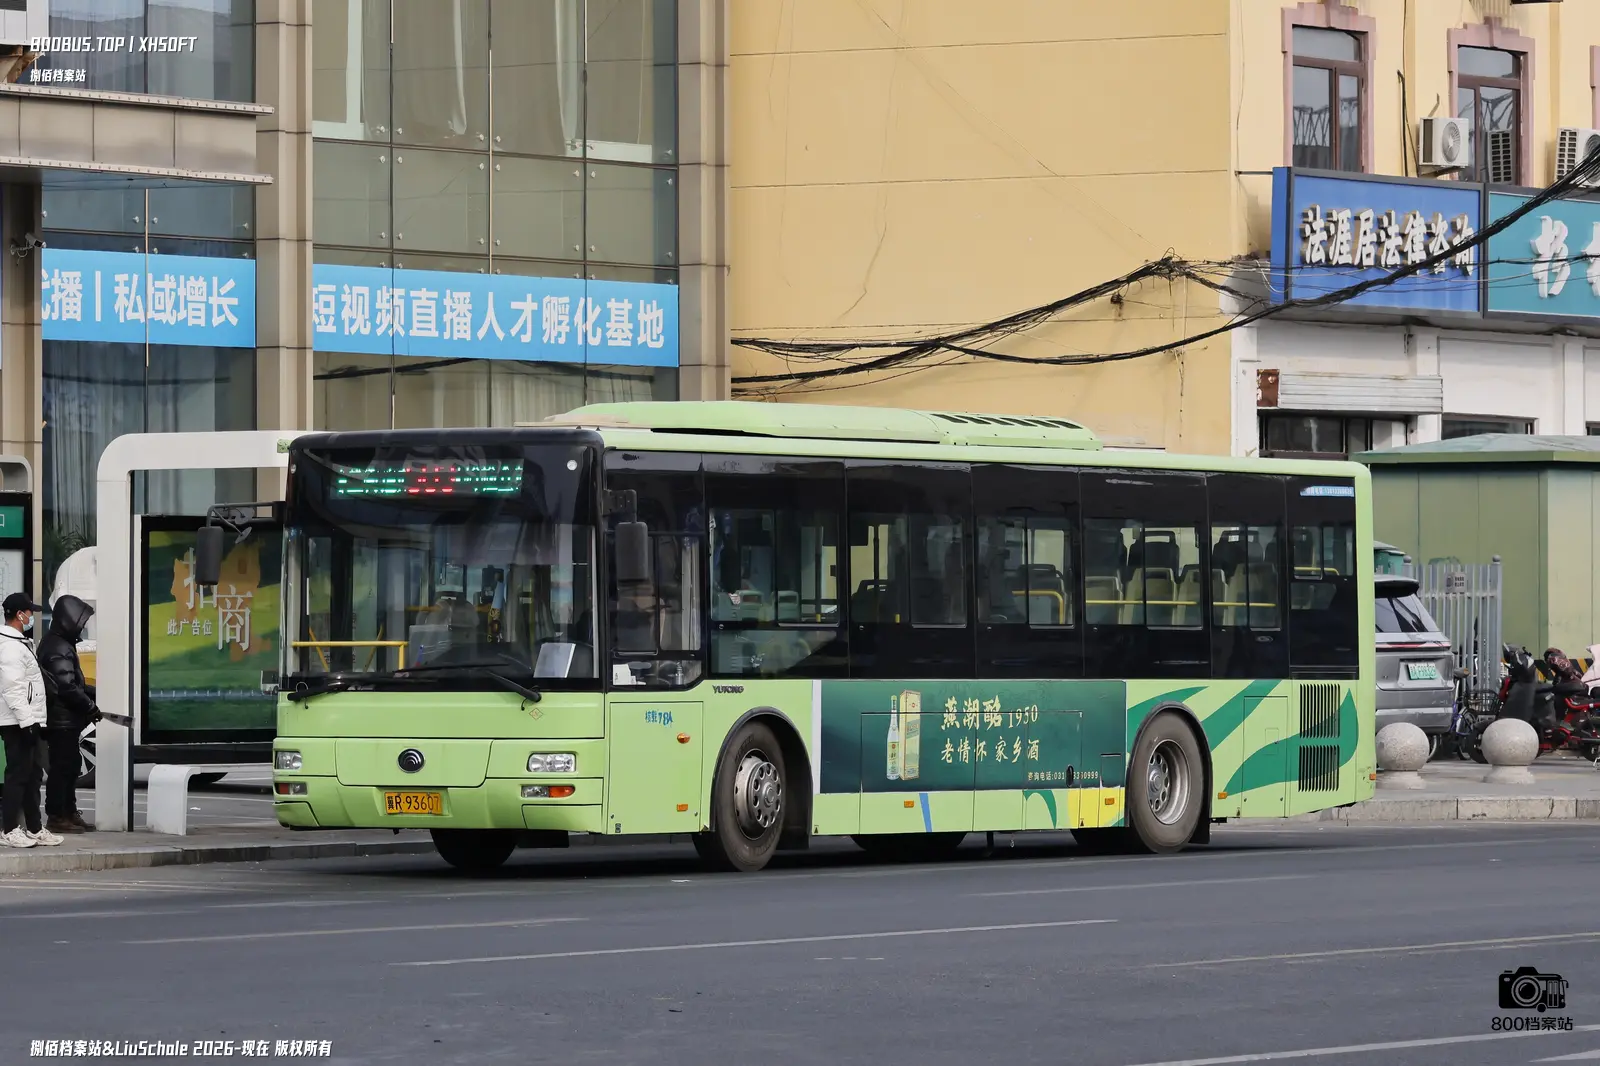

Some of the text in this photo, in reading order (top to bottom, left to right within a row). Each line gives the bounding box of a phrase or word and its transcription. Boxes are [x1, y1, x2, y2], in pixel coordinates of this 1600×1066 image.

[313, 283, 665, 349] 短视频直播人才孵化基地
[167, 619, 212, 636] 此广告位
[711, 685, 745, 694] YUTONG
[1008, 704, 1038, 729] 1950
